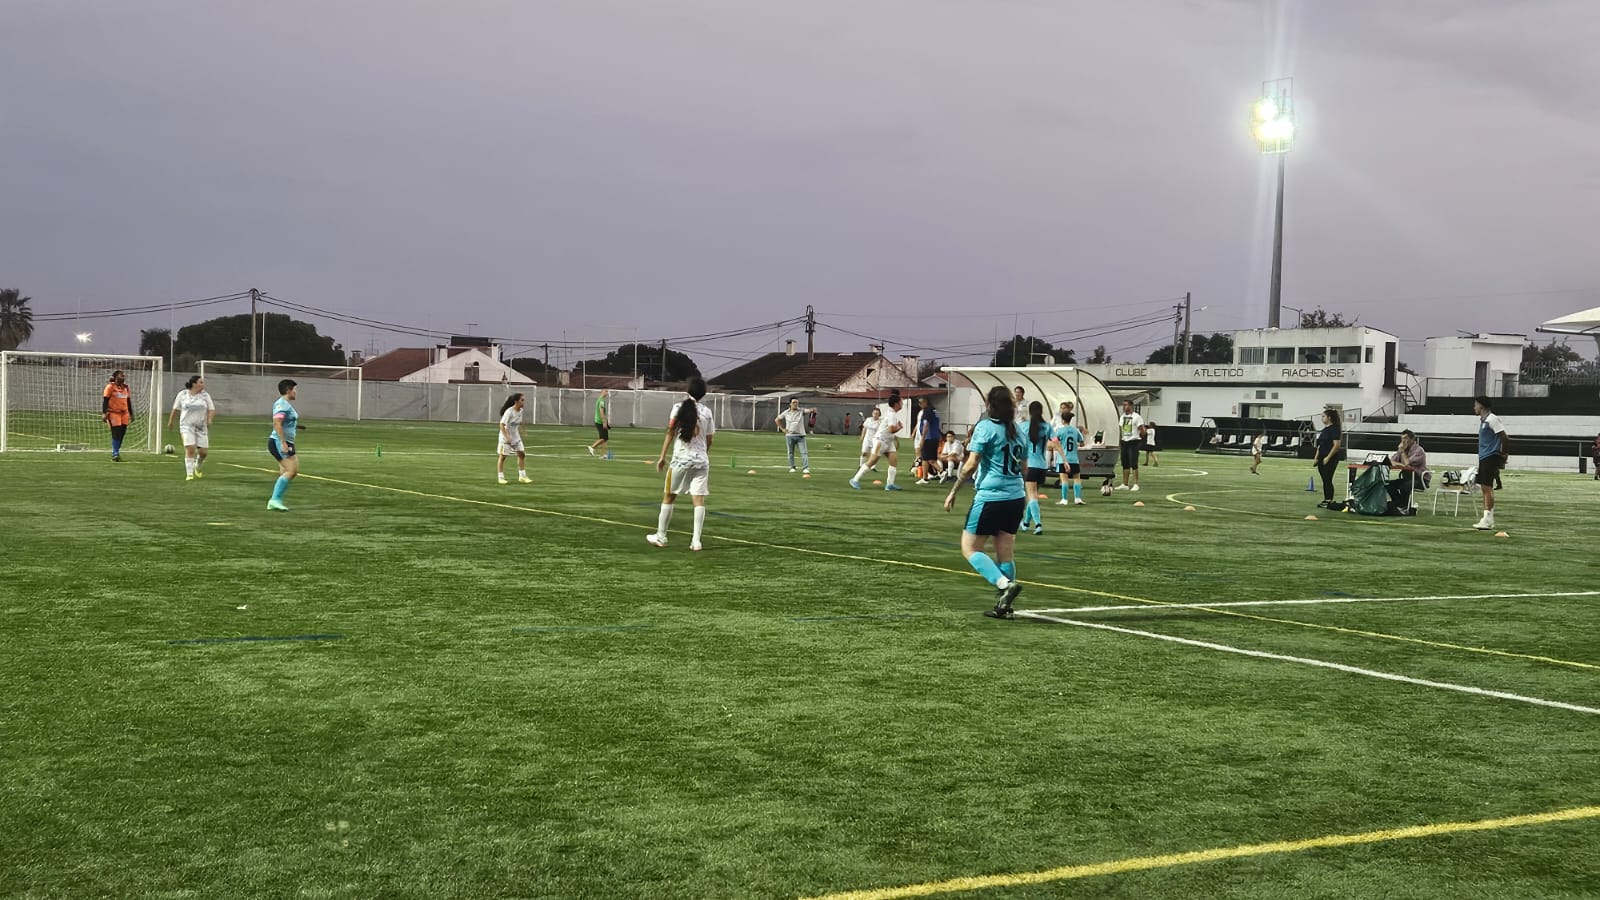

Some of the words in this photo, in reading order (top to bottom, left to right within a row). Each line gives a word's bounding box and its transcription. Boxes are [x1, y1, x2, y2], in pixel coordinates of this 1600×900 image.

[1115, 368, 1147, 377] CLUBE
[1193, 368, 1244, 377] ATLETICO
[1282, 368, 1345, 377] RIACHENSE
[1066, 436, 1074, 452] 6
